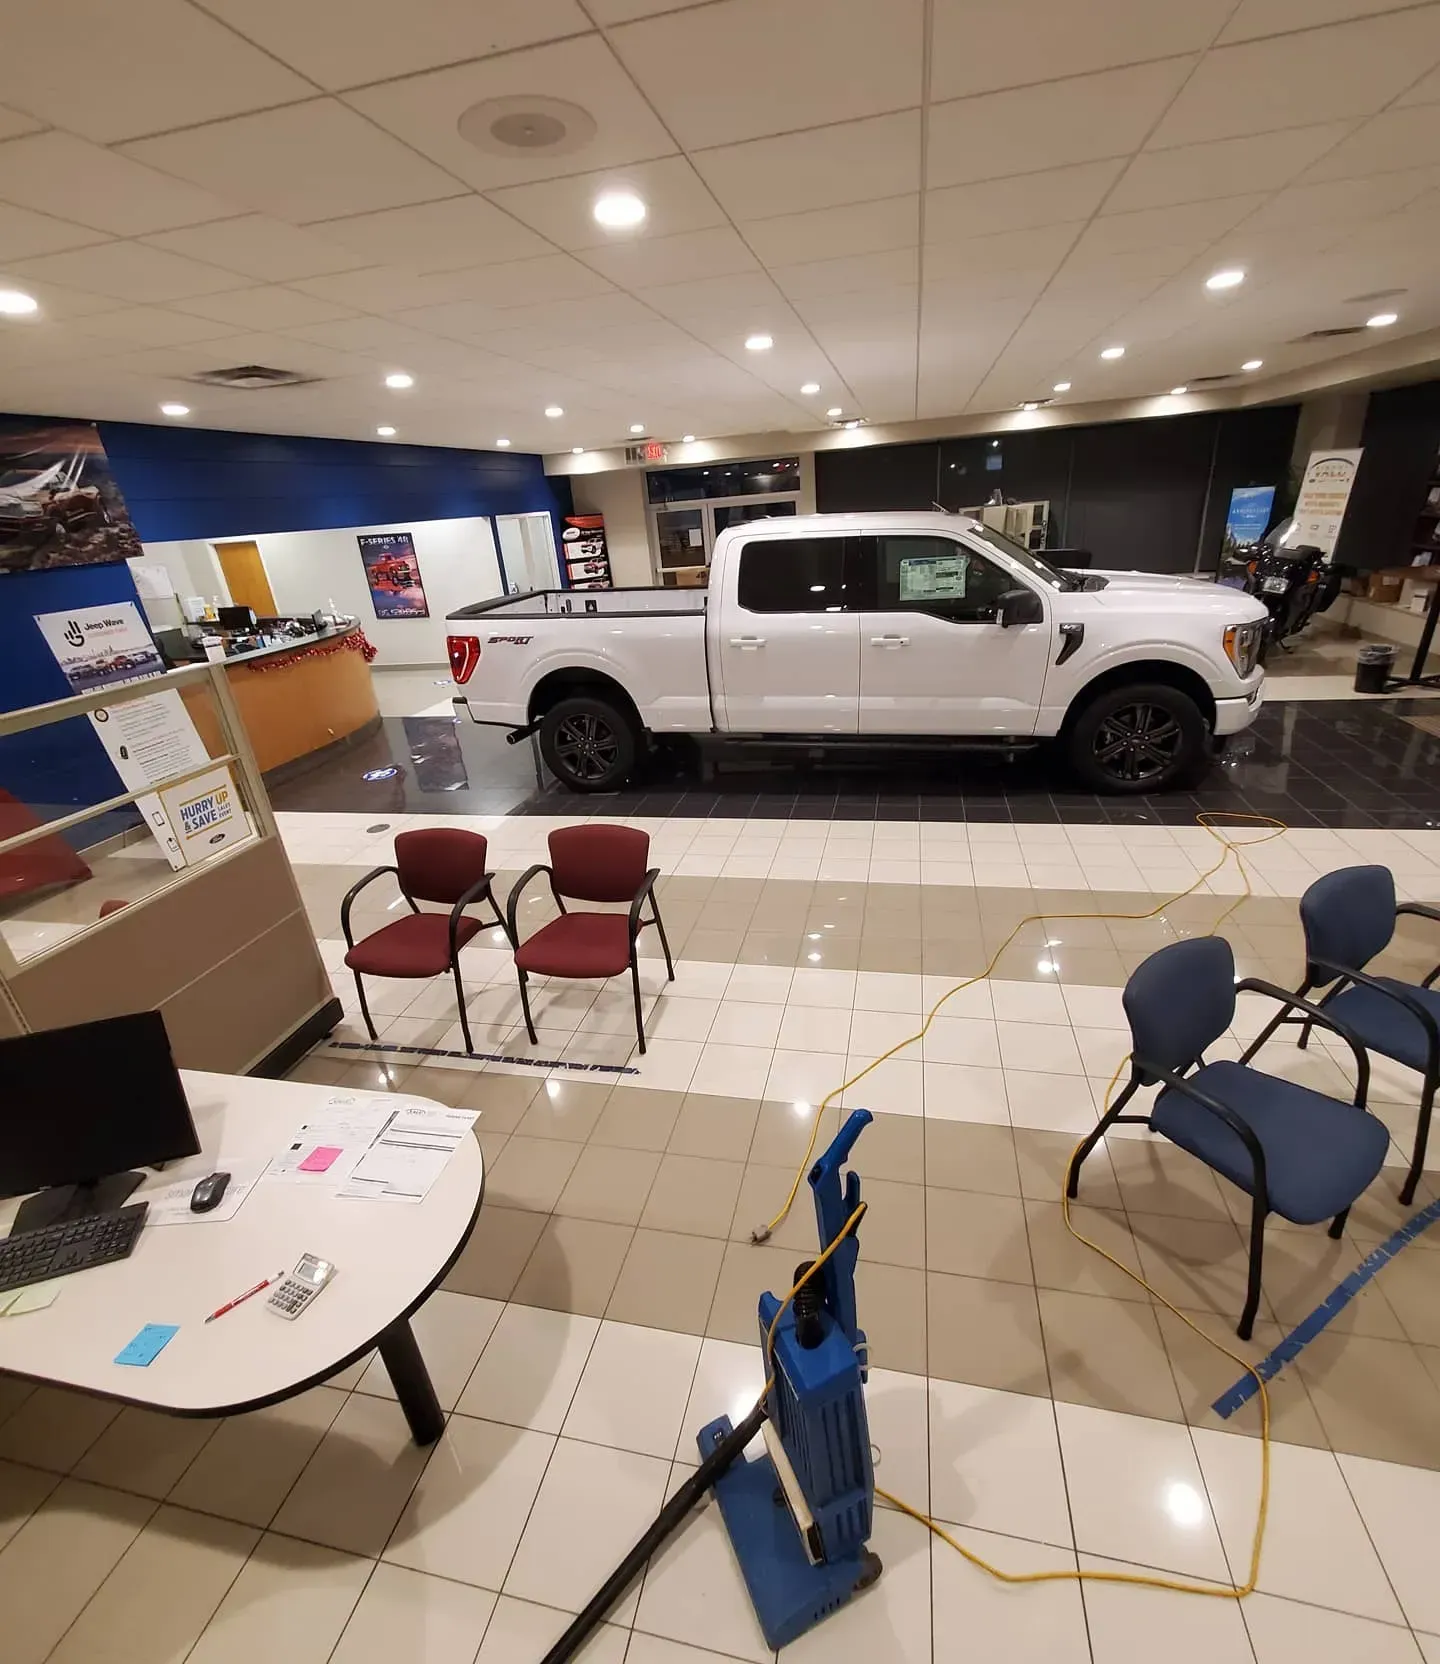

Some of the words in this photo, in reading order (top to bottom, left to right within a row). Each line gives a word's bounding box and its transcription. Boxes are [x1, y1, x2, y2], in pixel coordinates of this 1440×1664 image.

[360, 536, 396, 545] F-SERIES
[84, 621, 104, 631] Jeep
[103, 618, 125, 628] Wave
[488, 636, 534, 645] SPORT
[180, 796, 214, 820] HURRY
[215, 791, 229, 805] UP
[184, 821, 193, 834] &
[193, 809, 218, 830] SAVE
